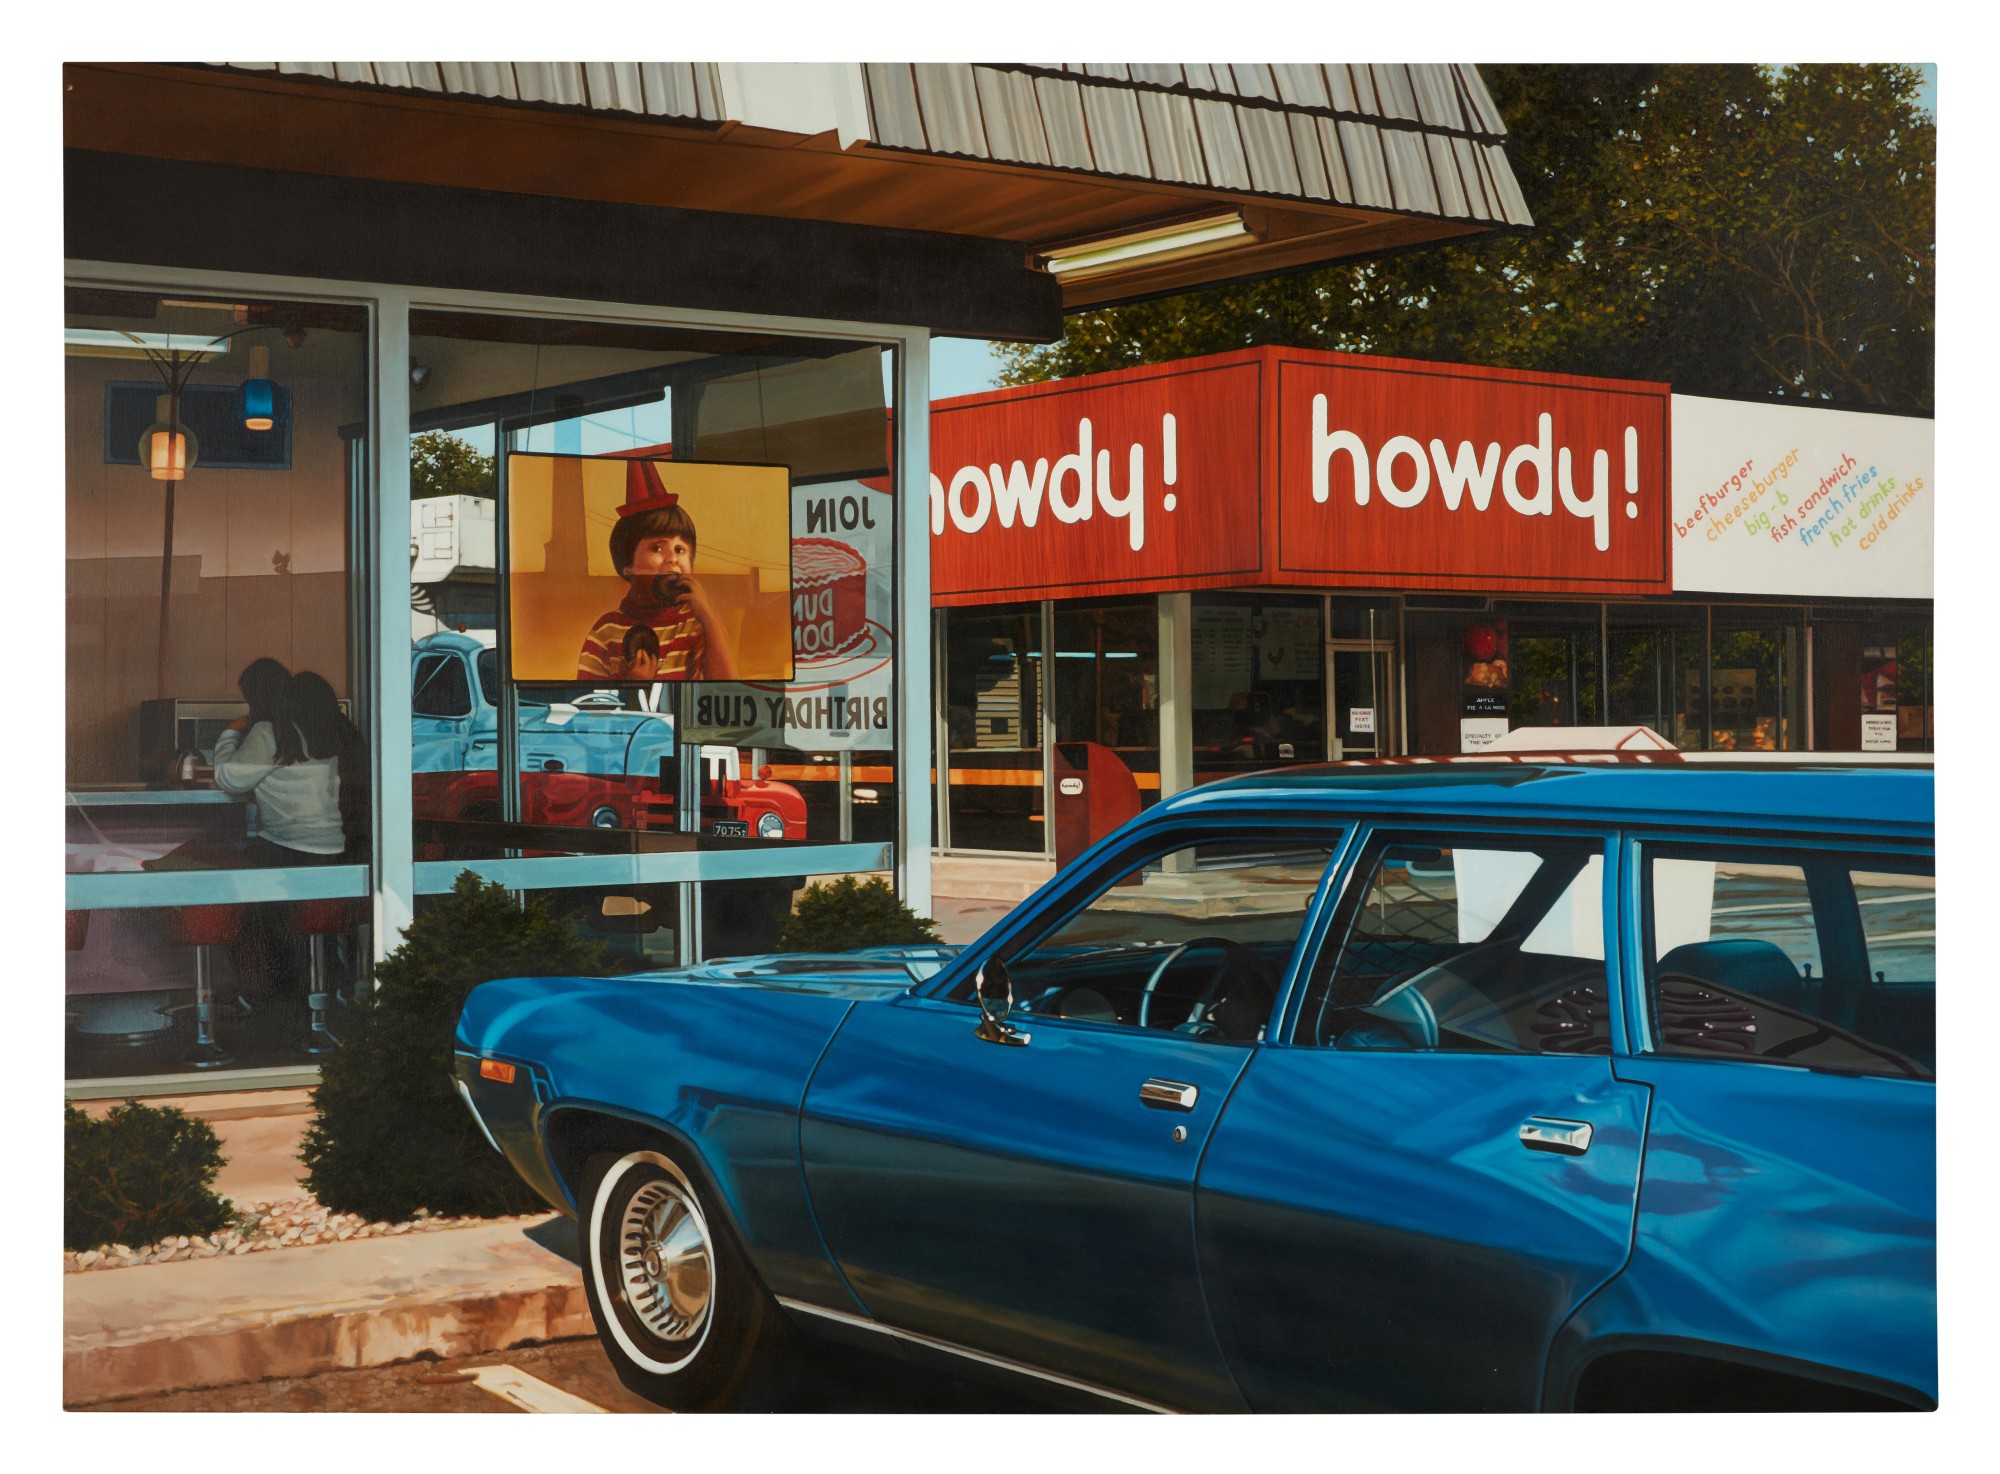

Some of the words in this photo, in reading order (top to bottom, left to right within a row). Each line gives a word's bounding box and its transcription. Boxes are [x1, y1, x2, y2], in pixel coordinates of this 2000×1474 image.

[1312, 393, 1638, 551] howdy!
[1673, 459, 1753, 538] beefburger
[1706, 448, 1799, 541] cheeseburger
[1771, 514, 1798, 543] fish
[1797, 453, 1857, 519] sandwich
[1799, 497, 1844, 546] french
[1842, 465, 1878, 503] fries
[1828, 517, 1858, 547] hot
[1859, 477, 1896, 519] drinks
[1743, 512, 1771, 537] big
[1859, 513, 1888, 550] cold
[1887, 477, 1924, 520] drinks
